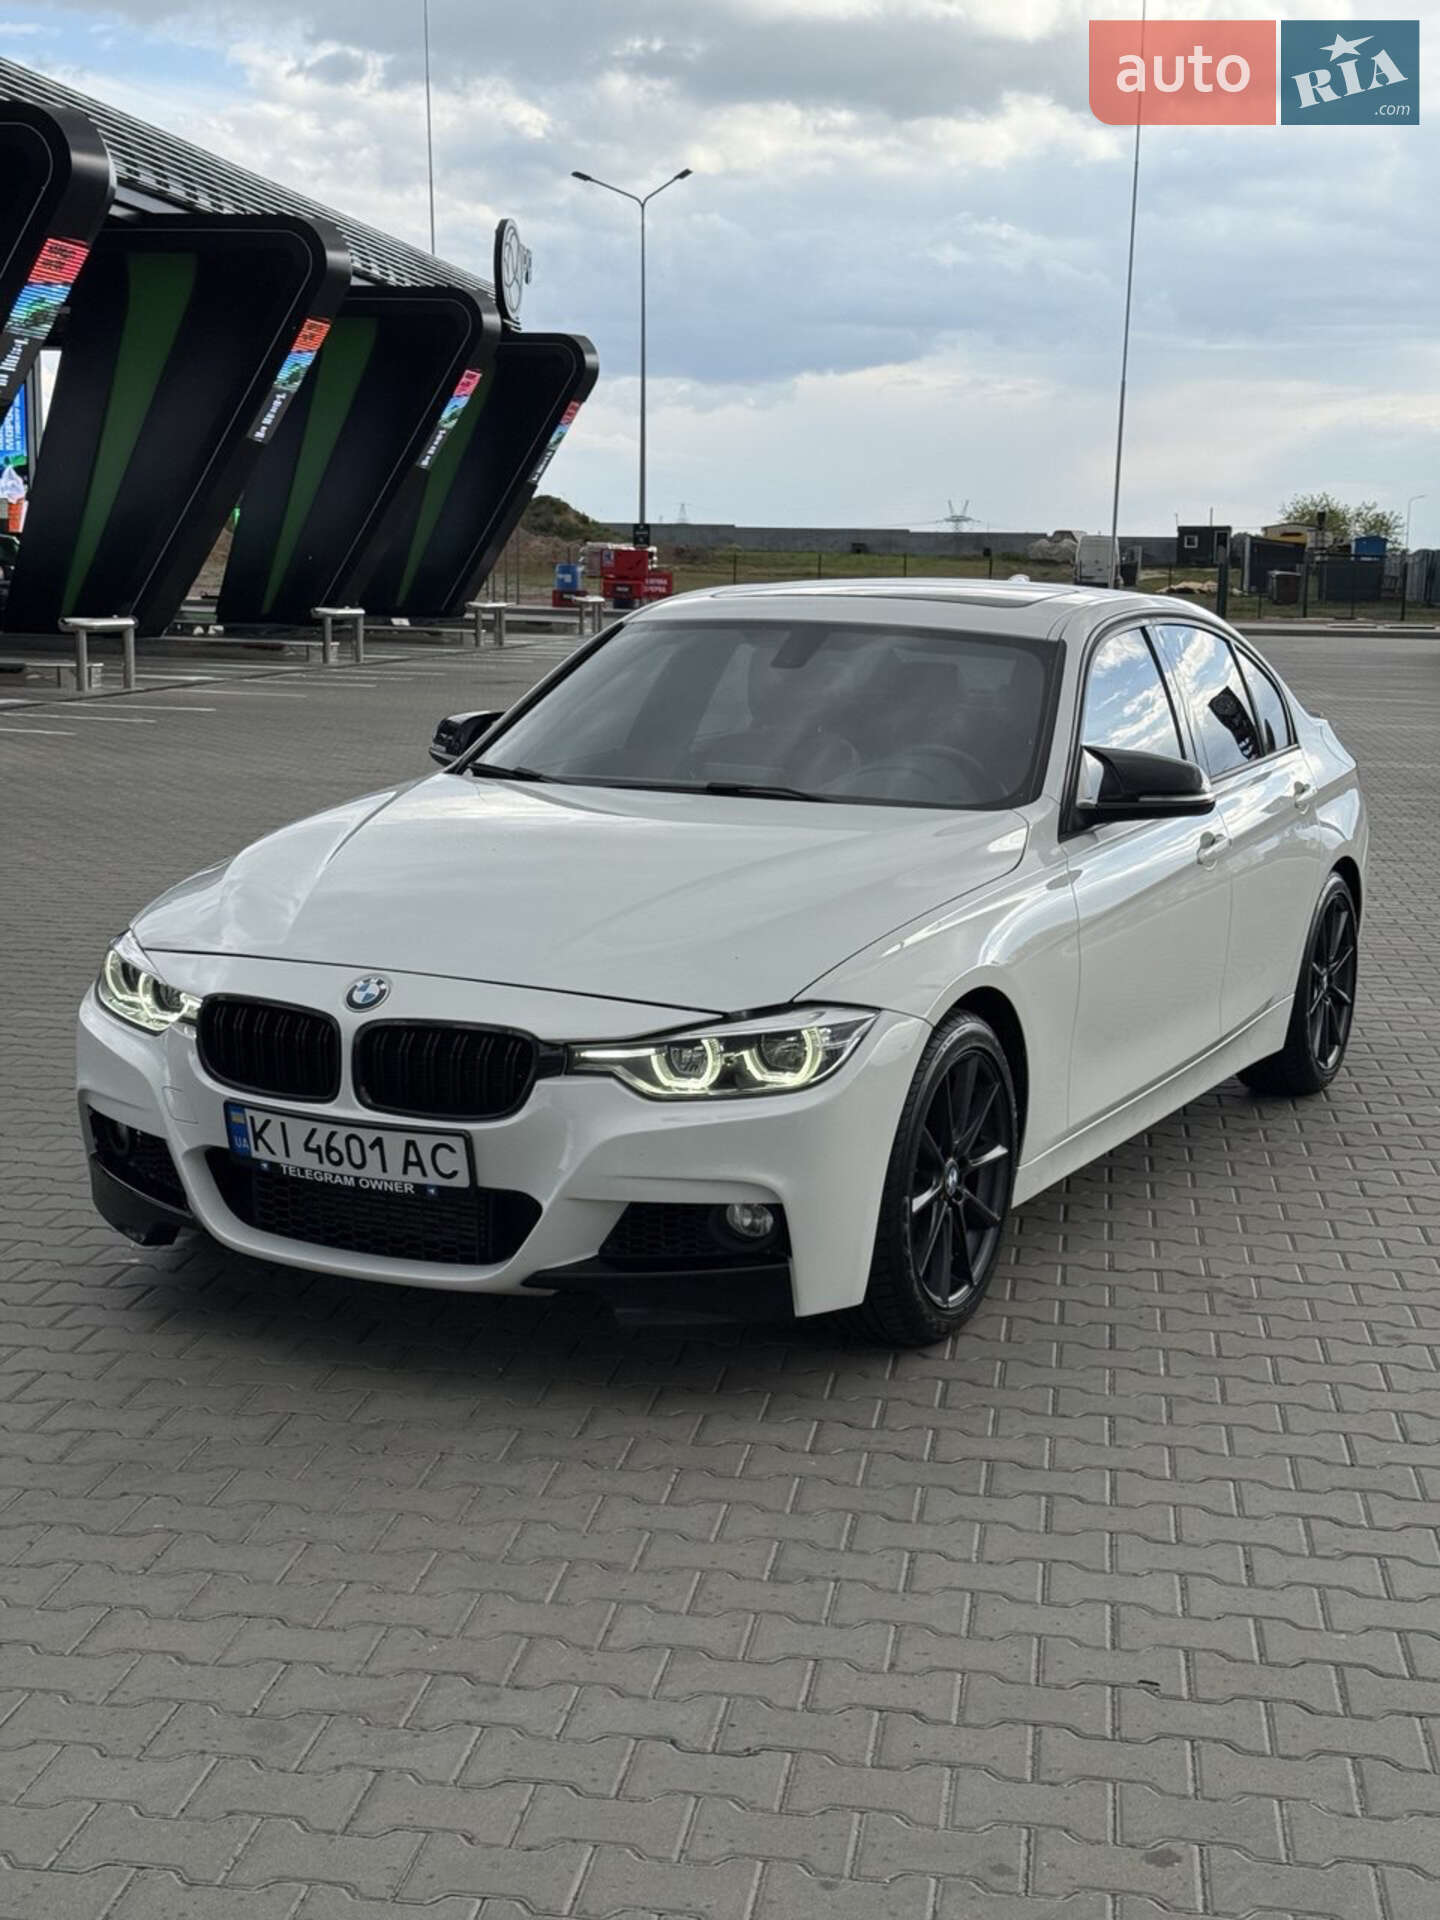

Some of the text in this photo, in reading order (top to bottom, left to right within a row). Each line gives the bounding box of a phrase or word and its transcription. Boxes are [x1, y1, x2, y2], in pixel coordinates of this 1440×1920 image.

[234, 1136, 250, 1149] UA
[249, 1115, 459, 1180] KI 4601 AC
[280, 1163, 415, 1195] TELEGRAM OWNER
